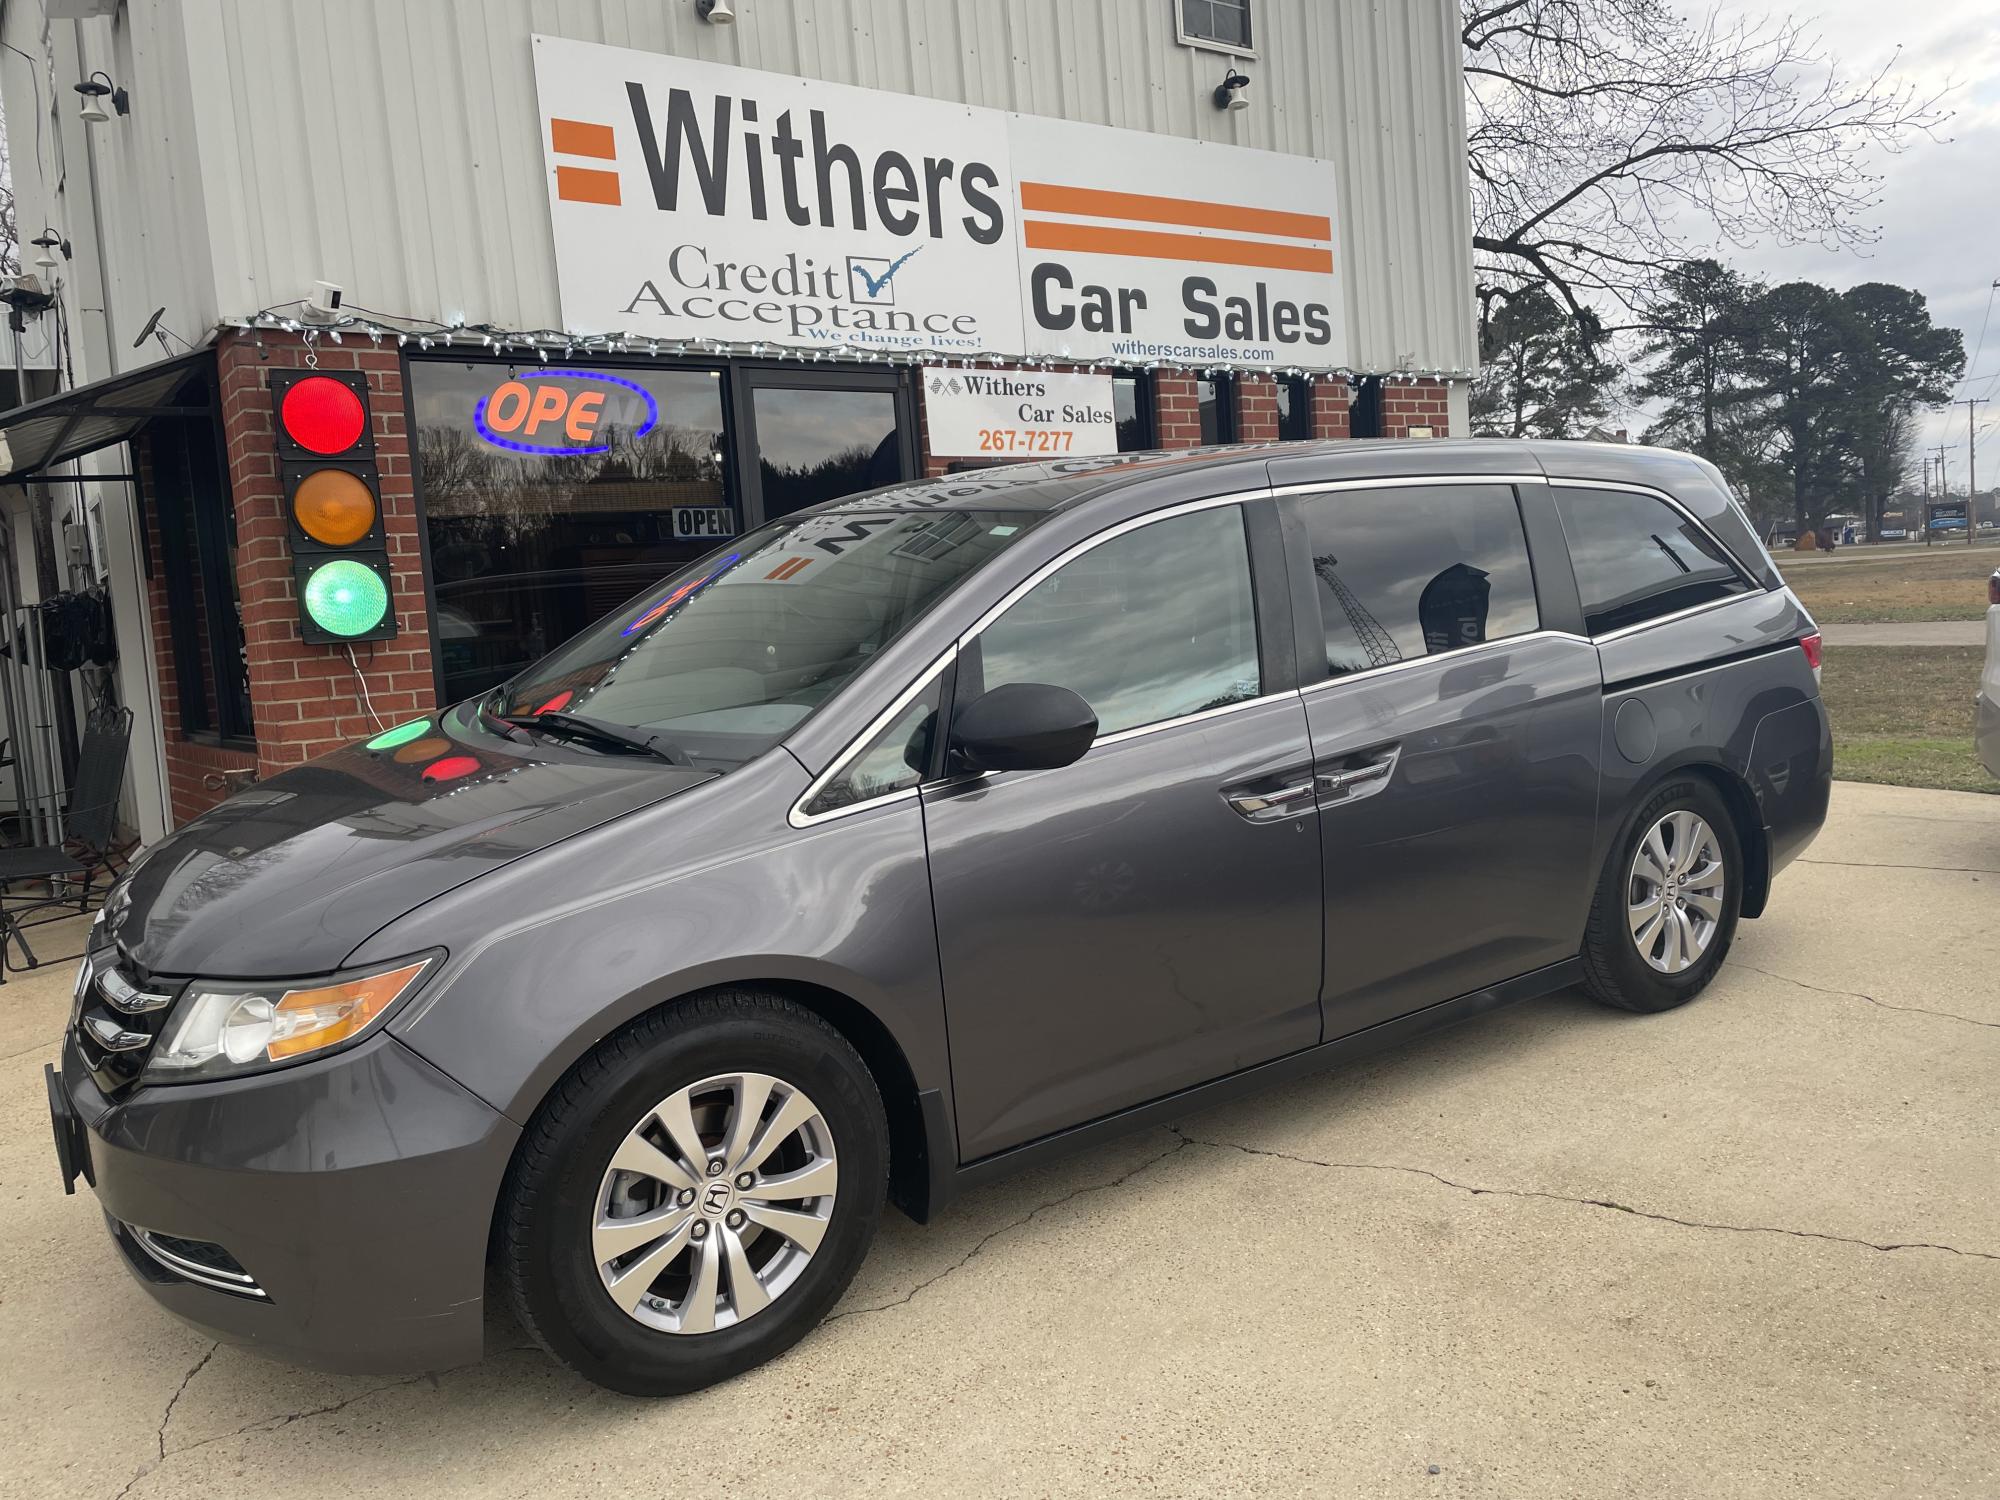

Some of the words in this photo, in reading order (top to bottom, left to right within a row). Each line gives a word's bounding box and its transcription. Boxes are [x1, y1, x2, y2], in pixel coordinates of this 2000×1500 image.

[624, 81, 1004, 245] Withers
[668, 245, 842, 300] Credit
[618, 279, 977, 337] Acceptance
[1030, 262, 1148, 334] Car
[1181, 276, 1332, 346] Sales
[808, 328, 842, 342] We
[849, 329, 923, 347] change
[931, 334, 983, 348] lives!
[1111, 340, 1274, 361] witherscarsales.com
[963, 375, 1046, 397] Withers
[1018, 404, 1052, 424] Car
[1062, 404, 1113, 424] Sales
[979, 429, 1073, 451] 267-7277
[678, 509, 732, 536] OPEN
